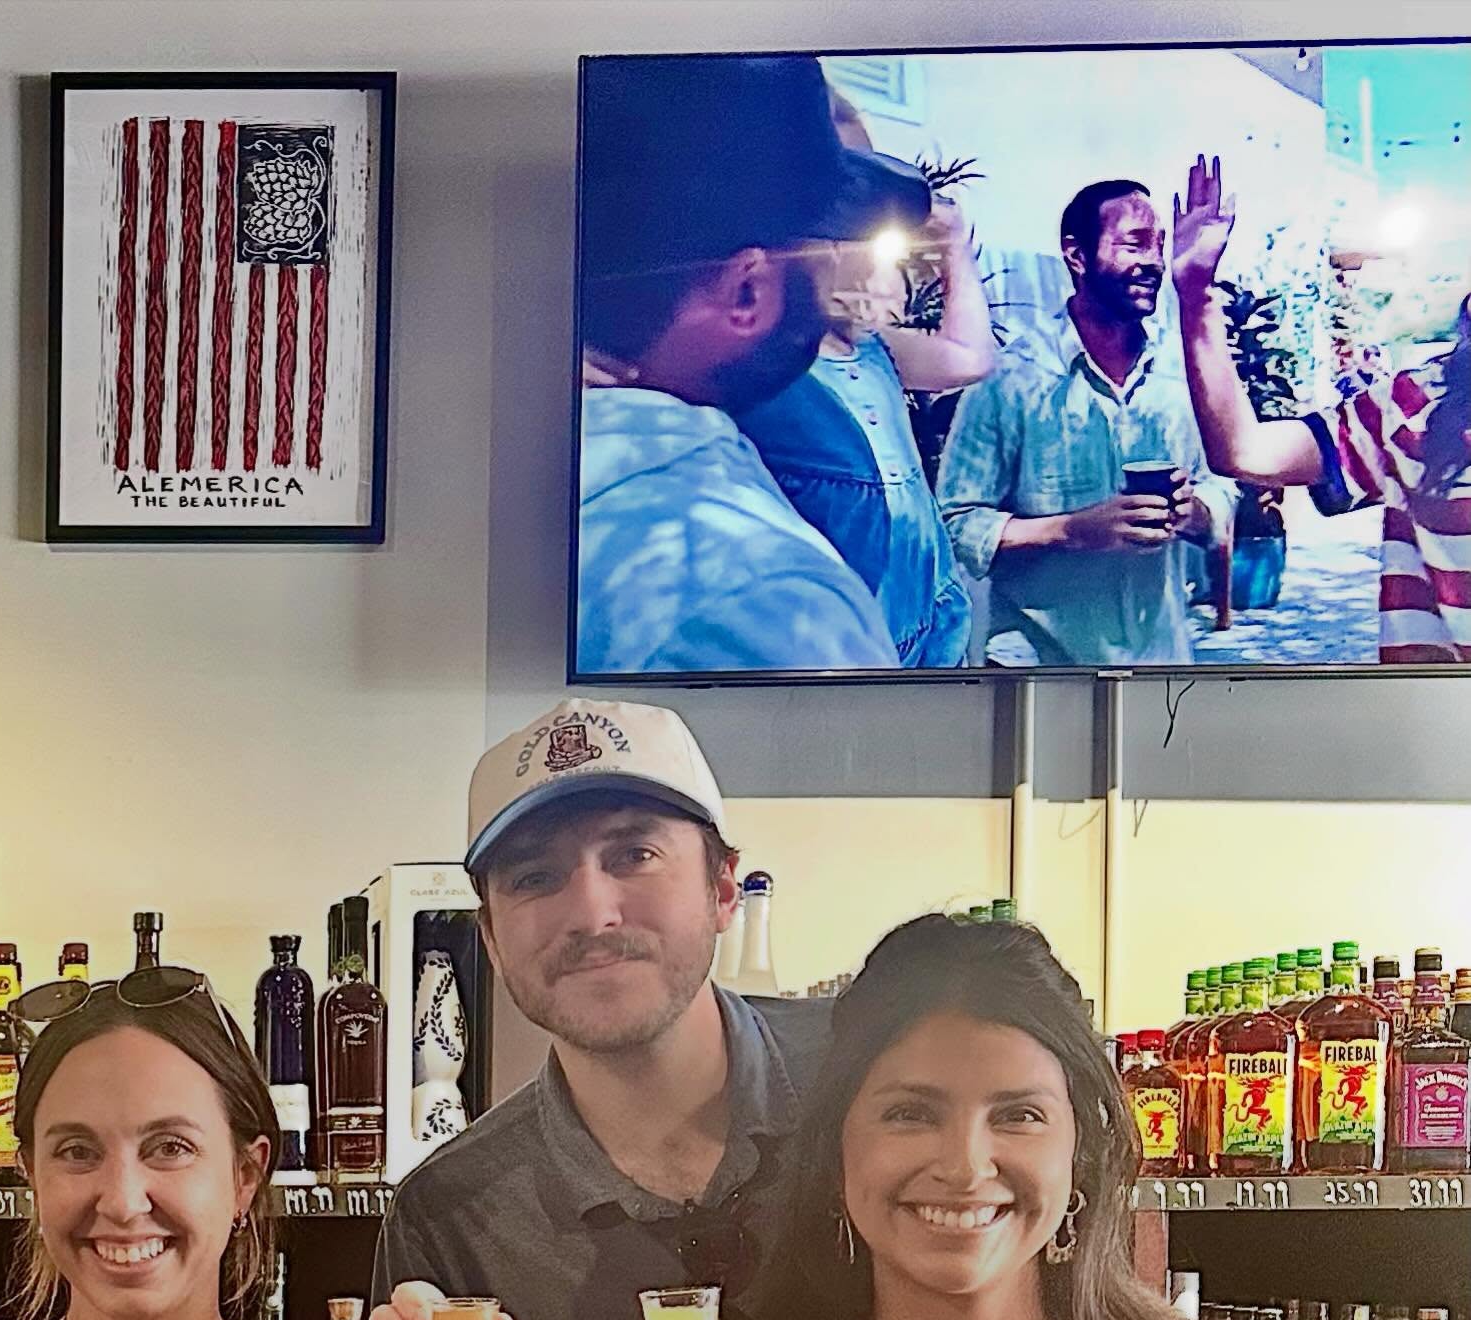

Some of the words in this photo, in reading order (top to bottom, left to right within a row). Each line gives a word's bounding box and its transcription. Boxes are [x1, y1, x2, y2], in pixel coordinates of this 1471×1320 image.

[117, 475, 303, 495] ALEMERICA
[131, 495, 168, 508] THE
[179, 495, 286, 508] BEAUTIFUL
[516, 726, 551, 778] GOLD
[553, 711, 632, 754] CANYON
[1323, 1046, 1378, 1063] FIREBAL
[1324, 1180, 1379, 1206] 25.99
